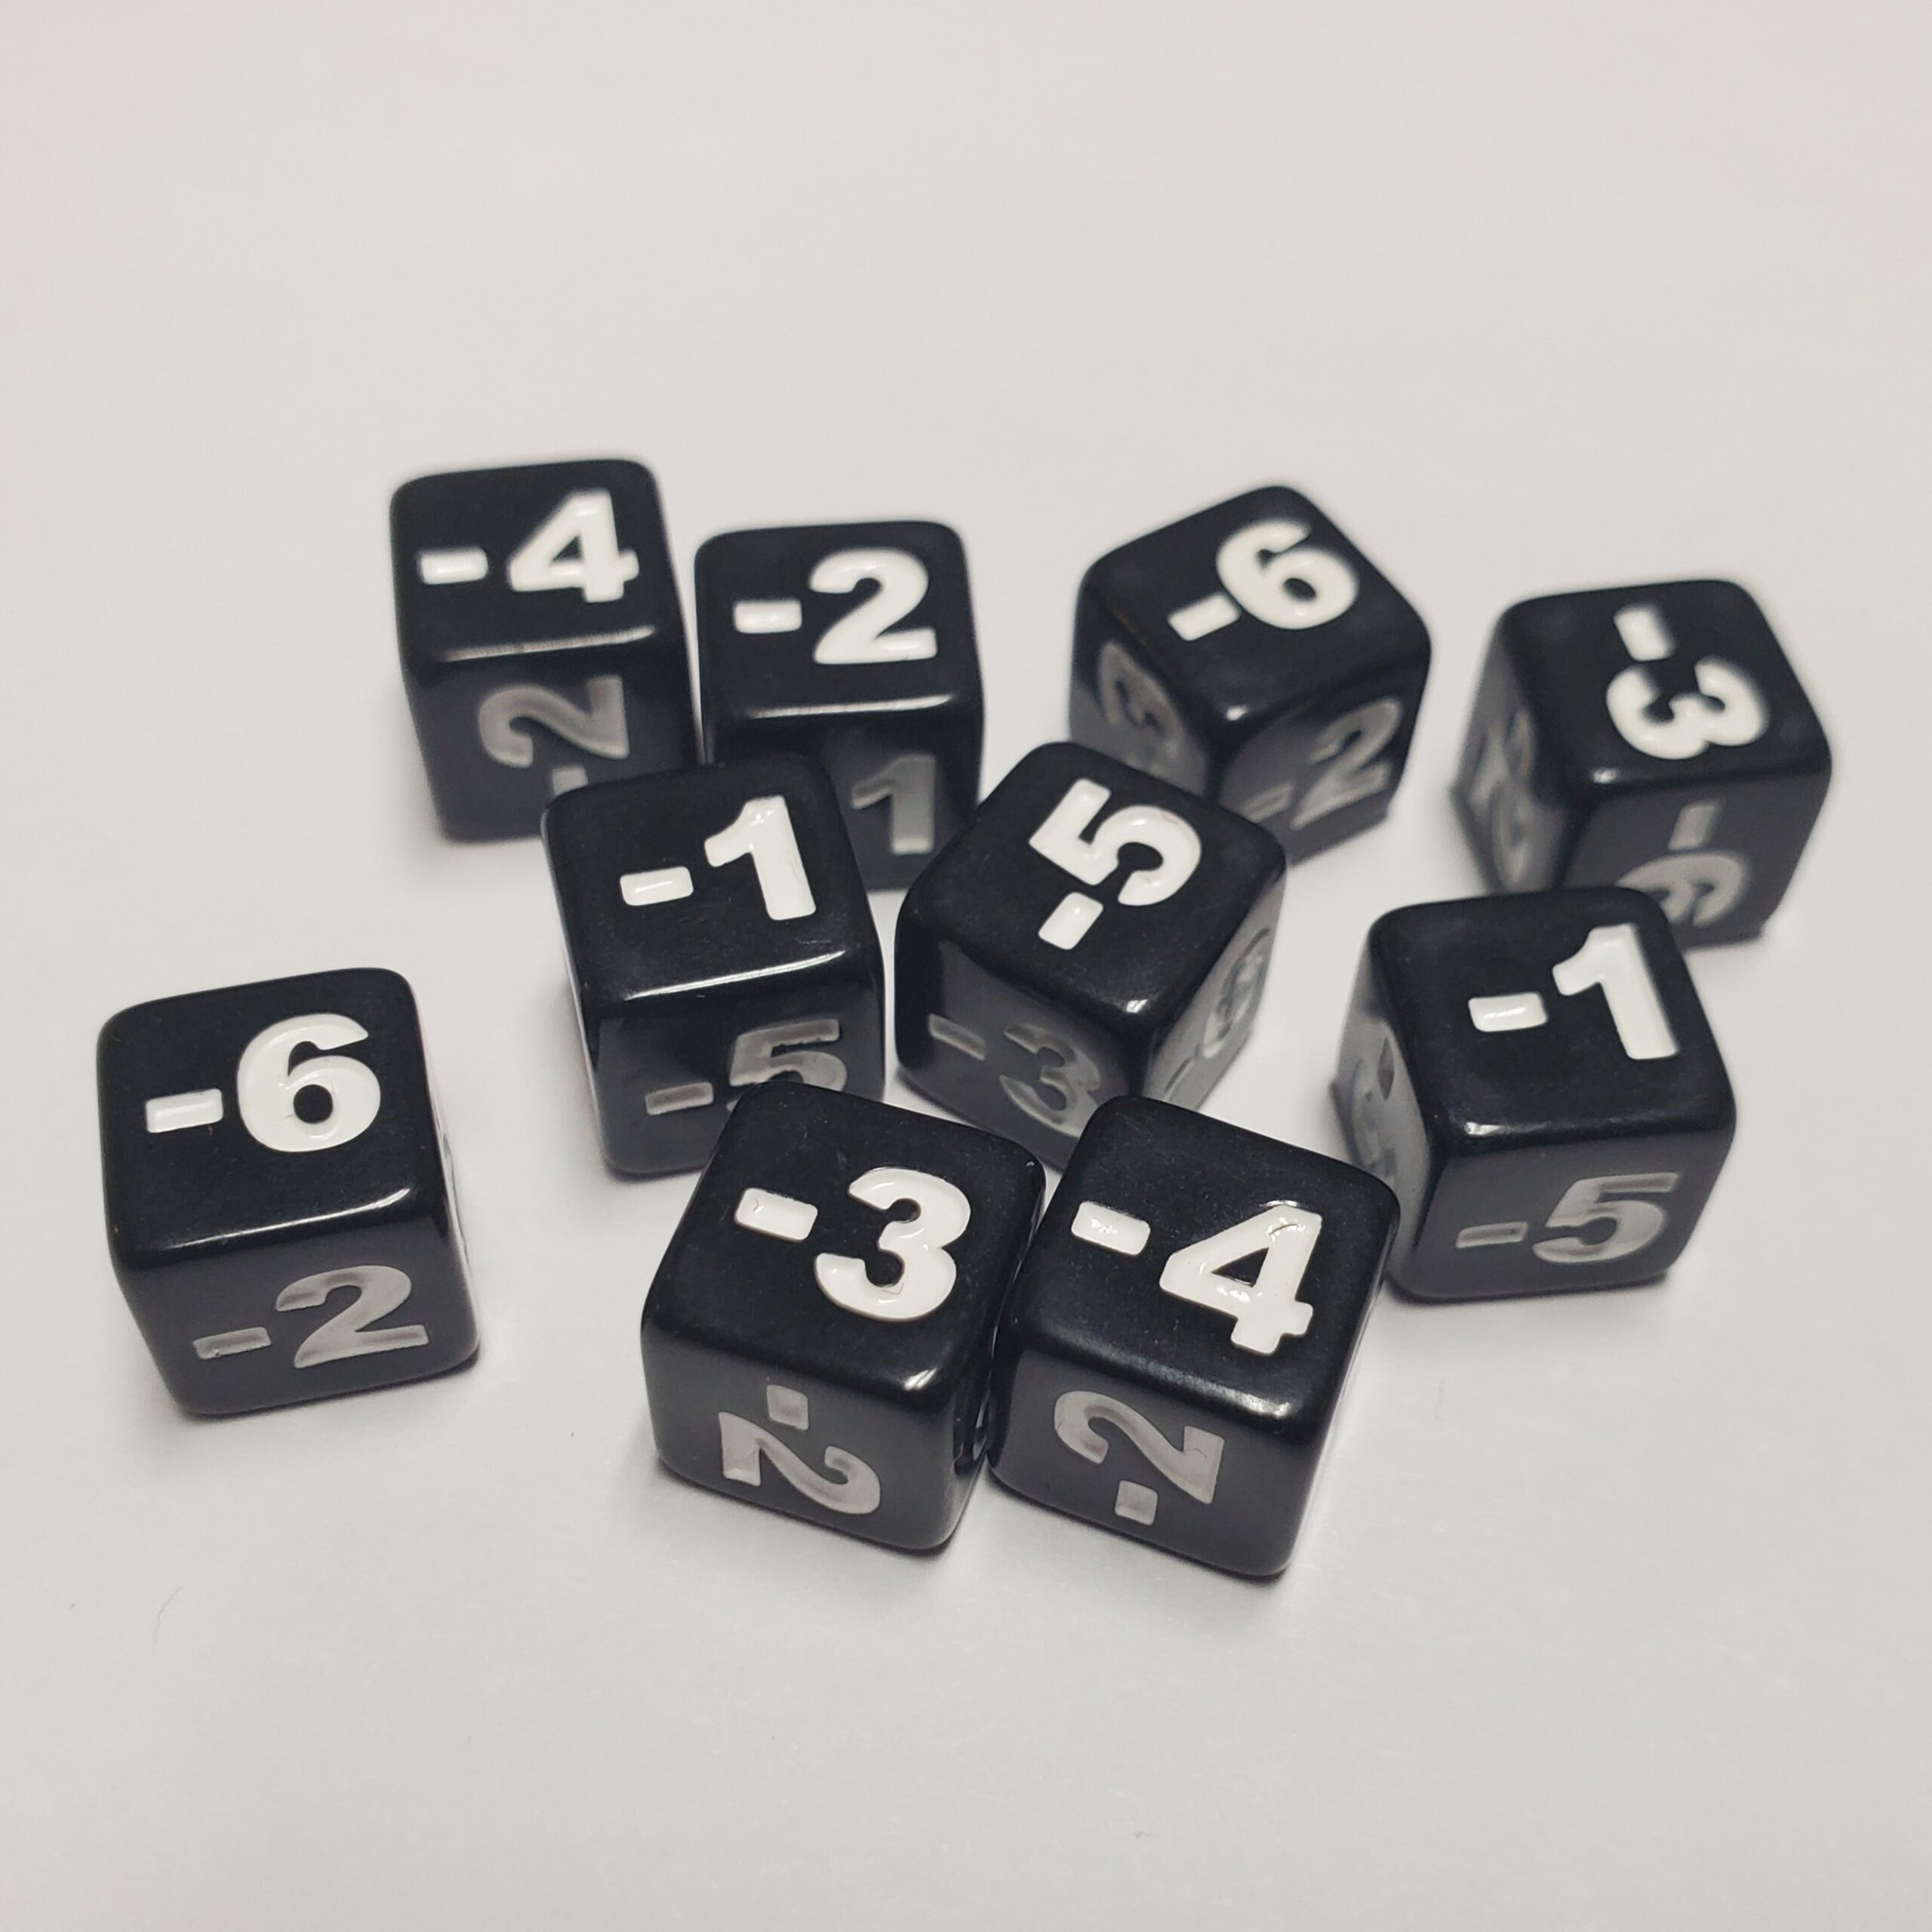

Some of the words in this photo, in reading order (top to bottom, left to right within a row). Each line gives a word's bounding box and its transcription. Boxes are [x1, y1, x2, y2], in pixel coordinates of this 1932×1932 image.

[417, 488, 639, 602] -4
[733, 548, 939, 665] -2
[1167, 519, 1359, 641] -6
[1605, 603, 1770, 760] -3
[1241, 697, 1401, 829] -2
[620, 795, 817, 921] -1
[1029, 777, 1201, 950] -5
[1468, 922, 1680, 1060] -1
[146, 1012, 380, 1152] -6
[645, 1018, 848, 1115] -5
[928, 1013, 1100, 1138] -3
[734, 1166, 971, 1322] -3
[1071, 1201, 1322, 1355] -4
[1455, 1172, 1681, 1265] -5
[192, 1265, 429, 1368] -2
[718, 1384, 881, 1514] -2
[1054, 1390, 1225, 1525] -2
